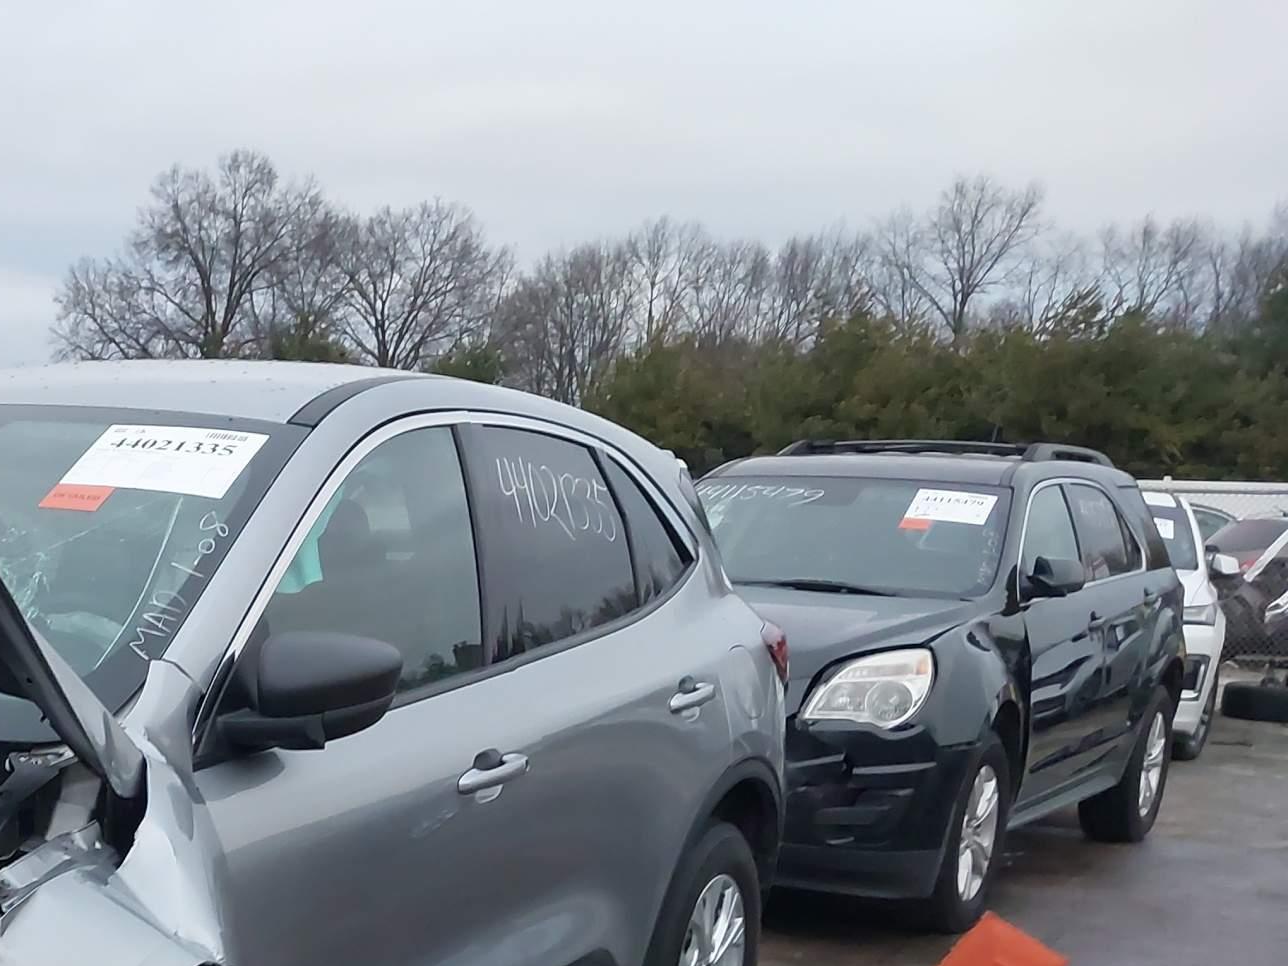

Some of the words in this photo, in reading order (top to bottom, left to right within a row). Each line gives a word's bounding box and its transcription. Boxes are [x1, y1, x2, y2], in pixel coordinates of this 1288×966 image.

[109, 437, 238, 458] 44021335
[496, 456, 616, 542] 44021335
[129, 589, 187, 660] MAD
[170, 510, 229, 578] 1-08
